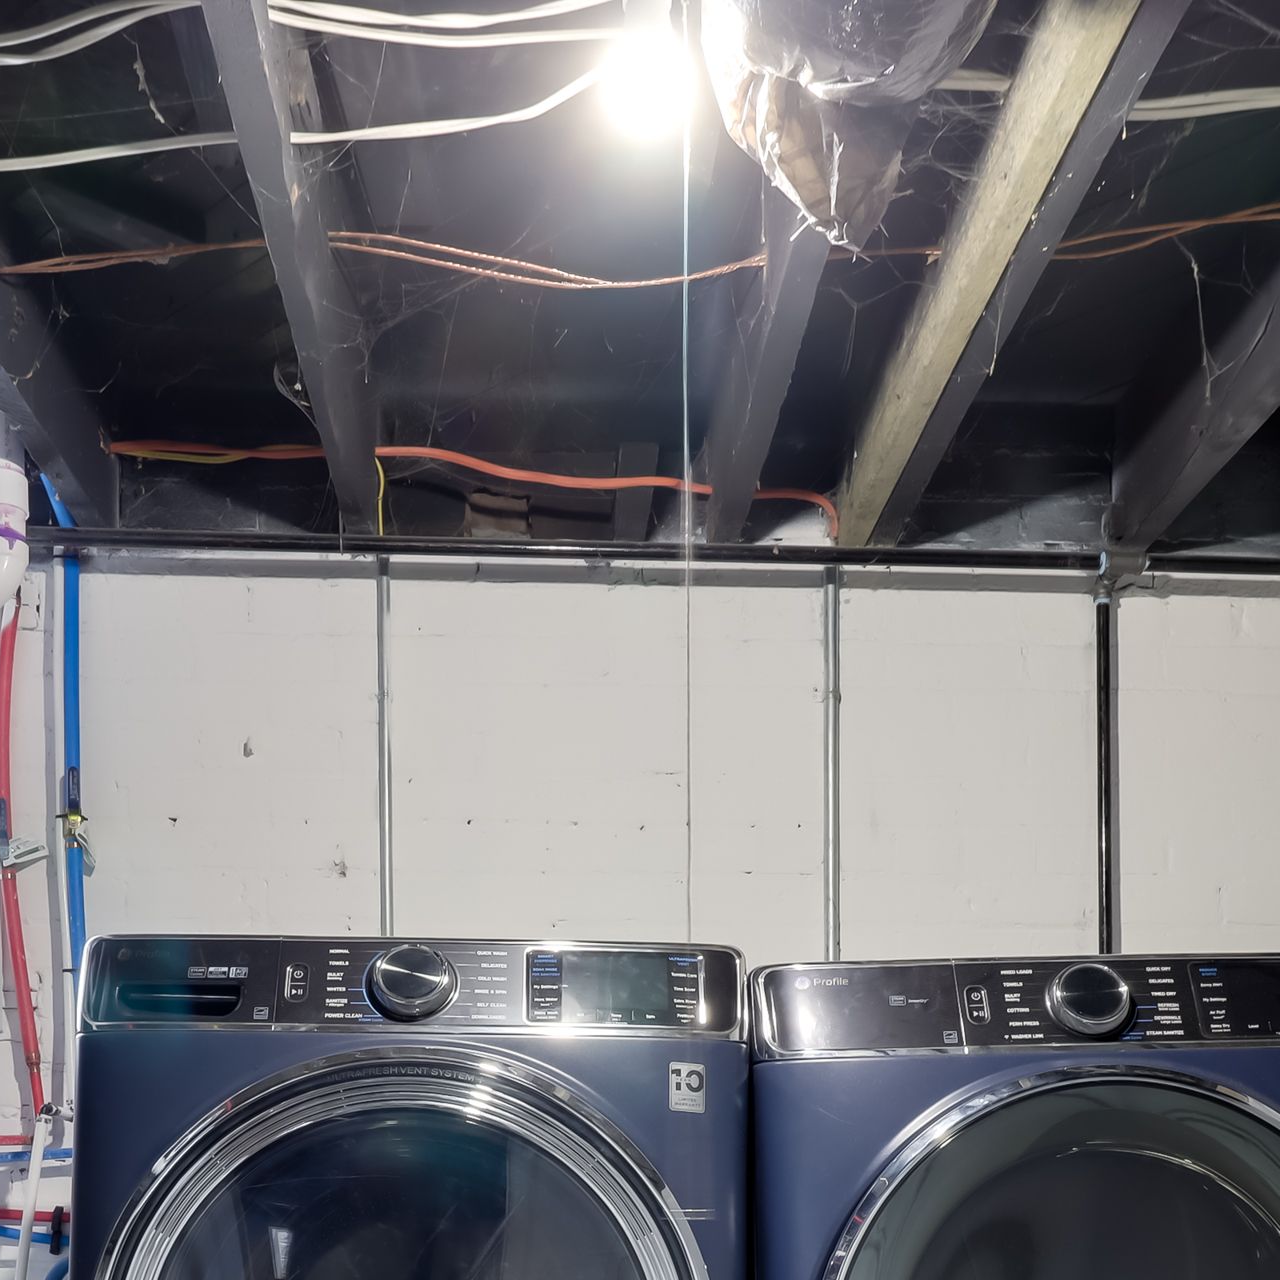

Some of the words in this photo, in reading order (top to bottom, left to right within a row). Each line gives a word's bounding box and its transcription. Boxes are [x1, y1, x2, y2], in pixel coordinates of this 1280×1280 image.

[813, 977, 849, 986] Profile
[399, 1066, 429, 1076] VENT
[430, 1067, 476, 1083] SYSTEM
[671, 1069, 704, 1093] 10
